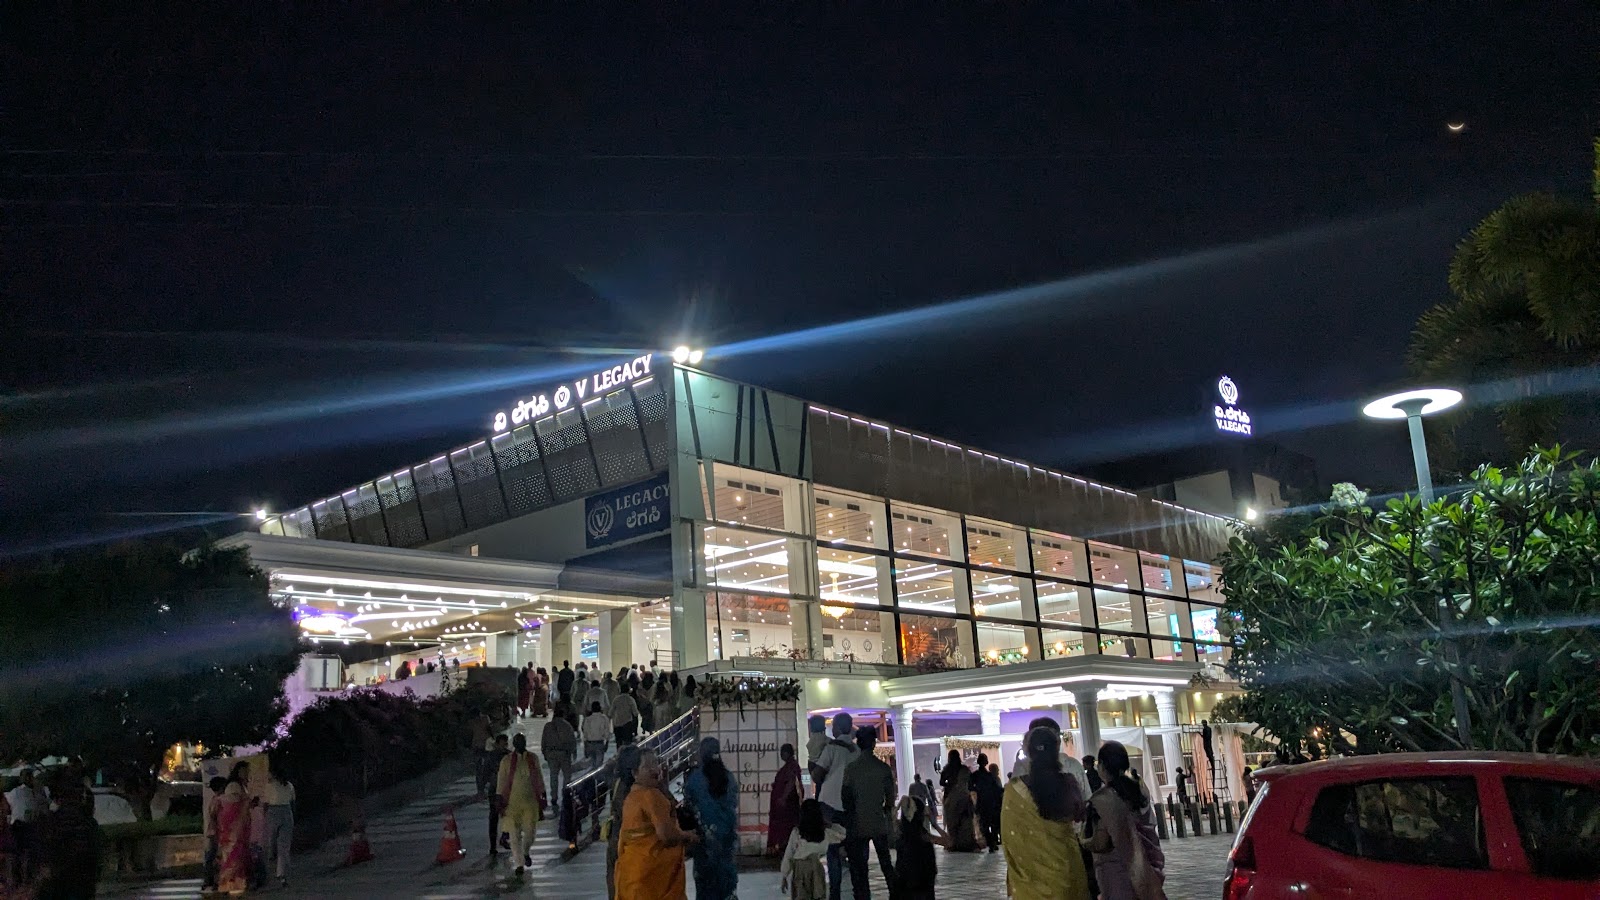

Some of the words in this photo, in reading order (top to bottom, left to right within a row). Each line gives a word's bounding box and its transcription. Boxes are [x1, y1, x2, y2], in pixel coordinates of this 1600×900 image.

[575, 379, 588, 398] V
[593, 354, 652, 393] LEGACY
[615, 483, 671, 511] LEGACY
[595, 512, 606, 527] V
[626, 505, 661, 528] ಲೆಗಸಿ
[720, 738, 777, 759] Ananya
[743, 762, 753, 777] &
